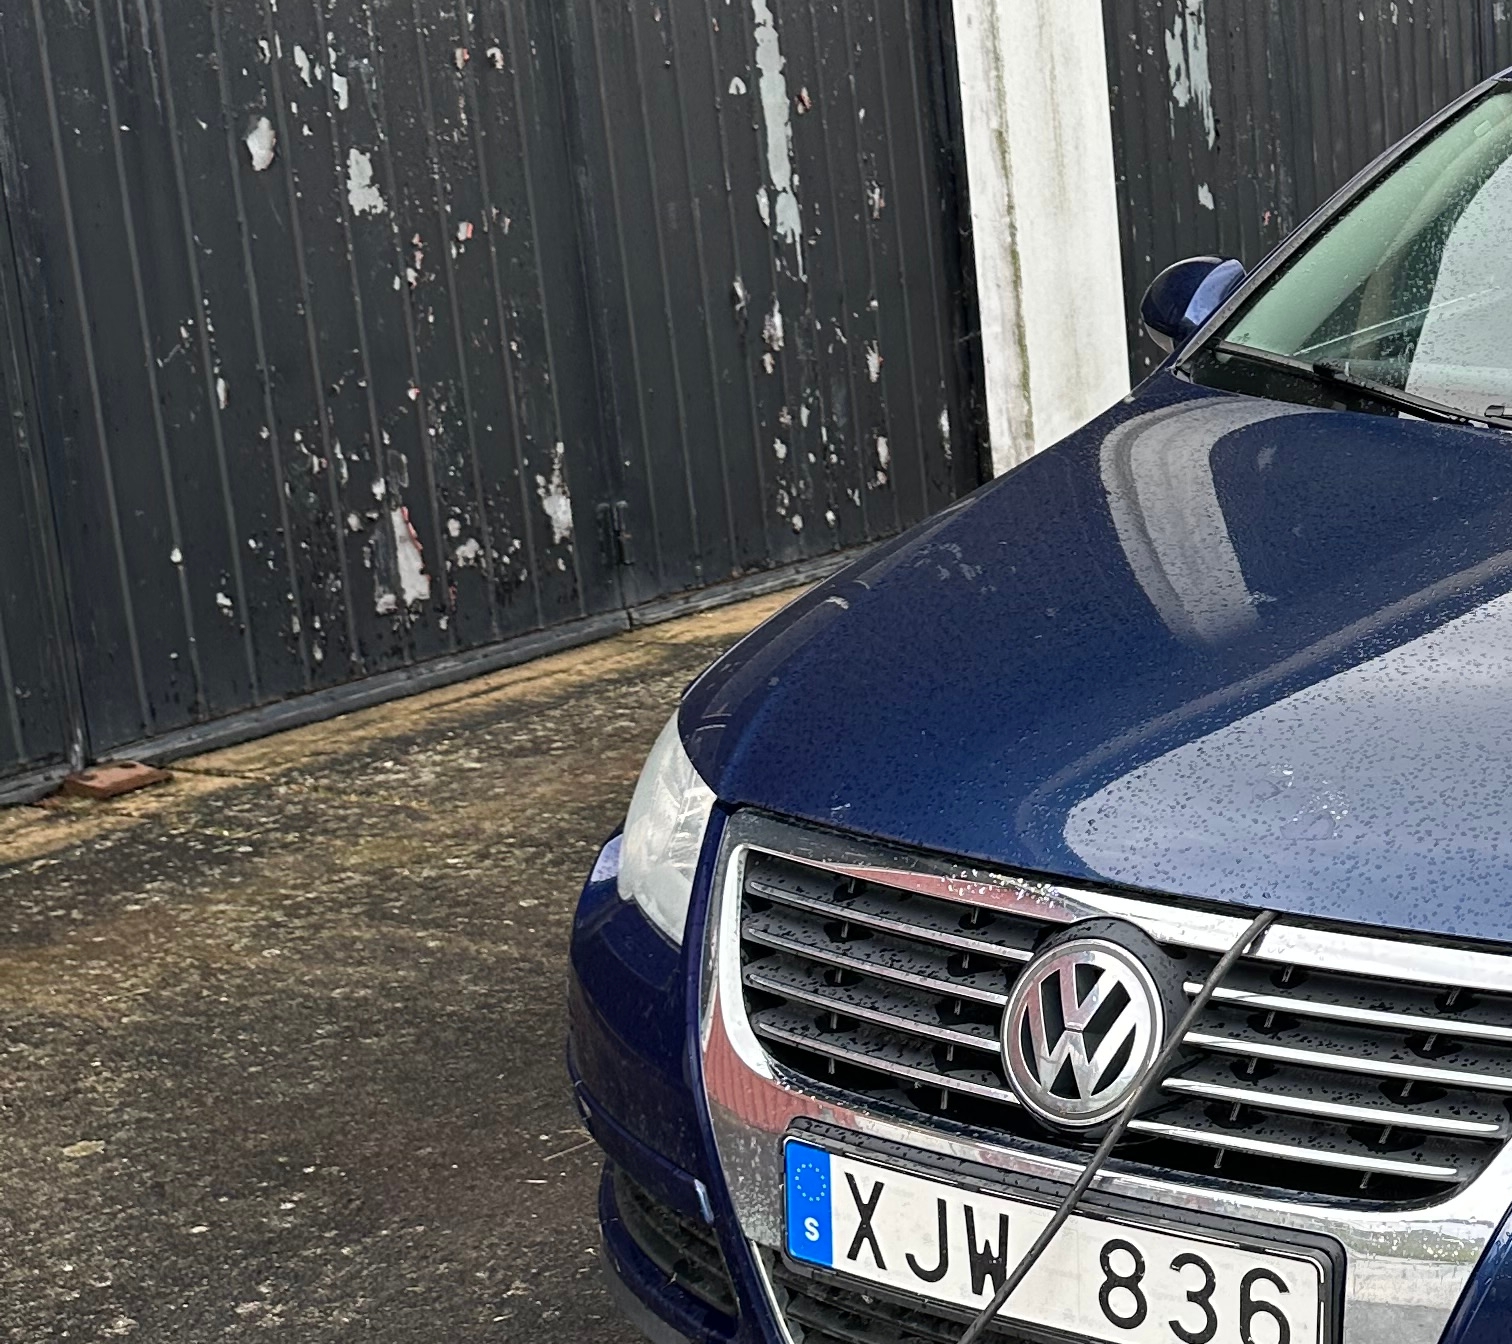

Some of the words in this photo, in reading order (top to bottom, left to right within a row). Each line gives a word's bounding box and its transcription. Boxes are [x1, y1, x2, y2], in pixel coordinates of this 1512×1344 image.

[1007, 944, 1159, 1119] VW
[804, 1217, 820, 1242] S
[844, 1171, 1009, 1297] XJW
